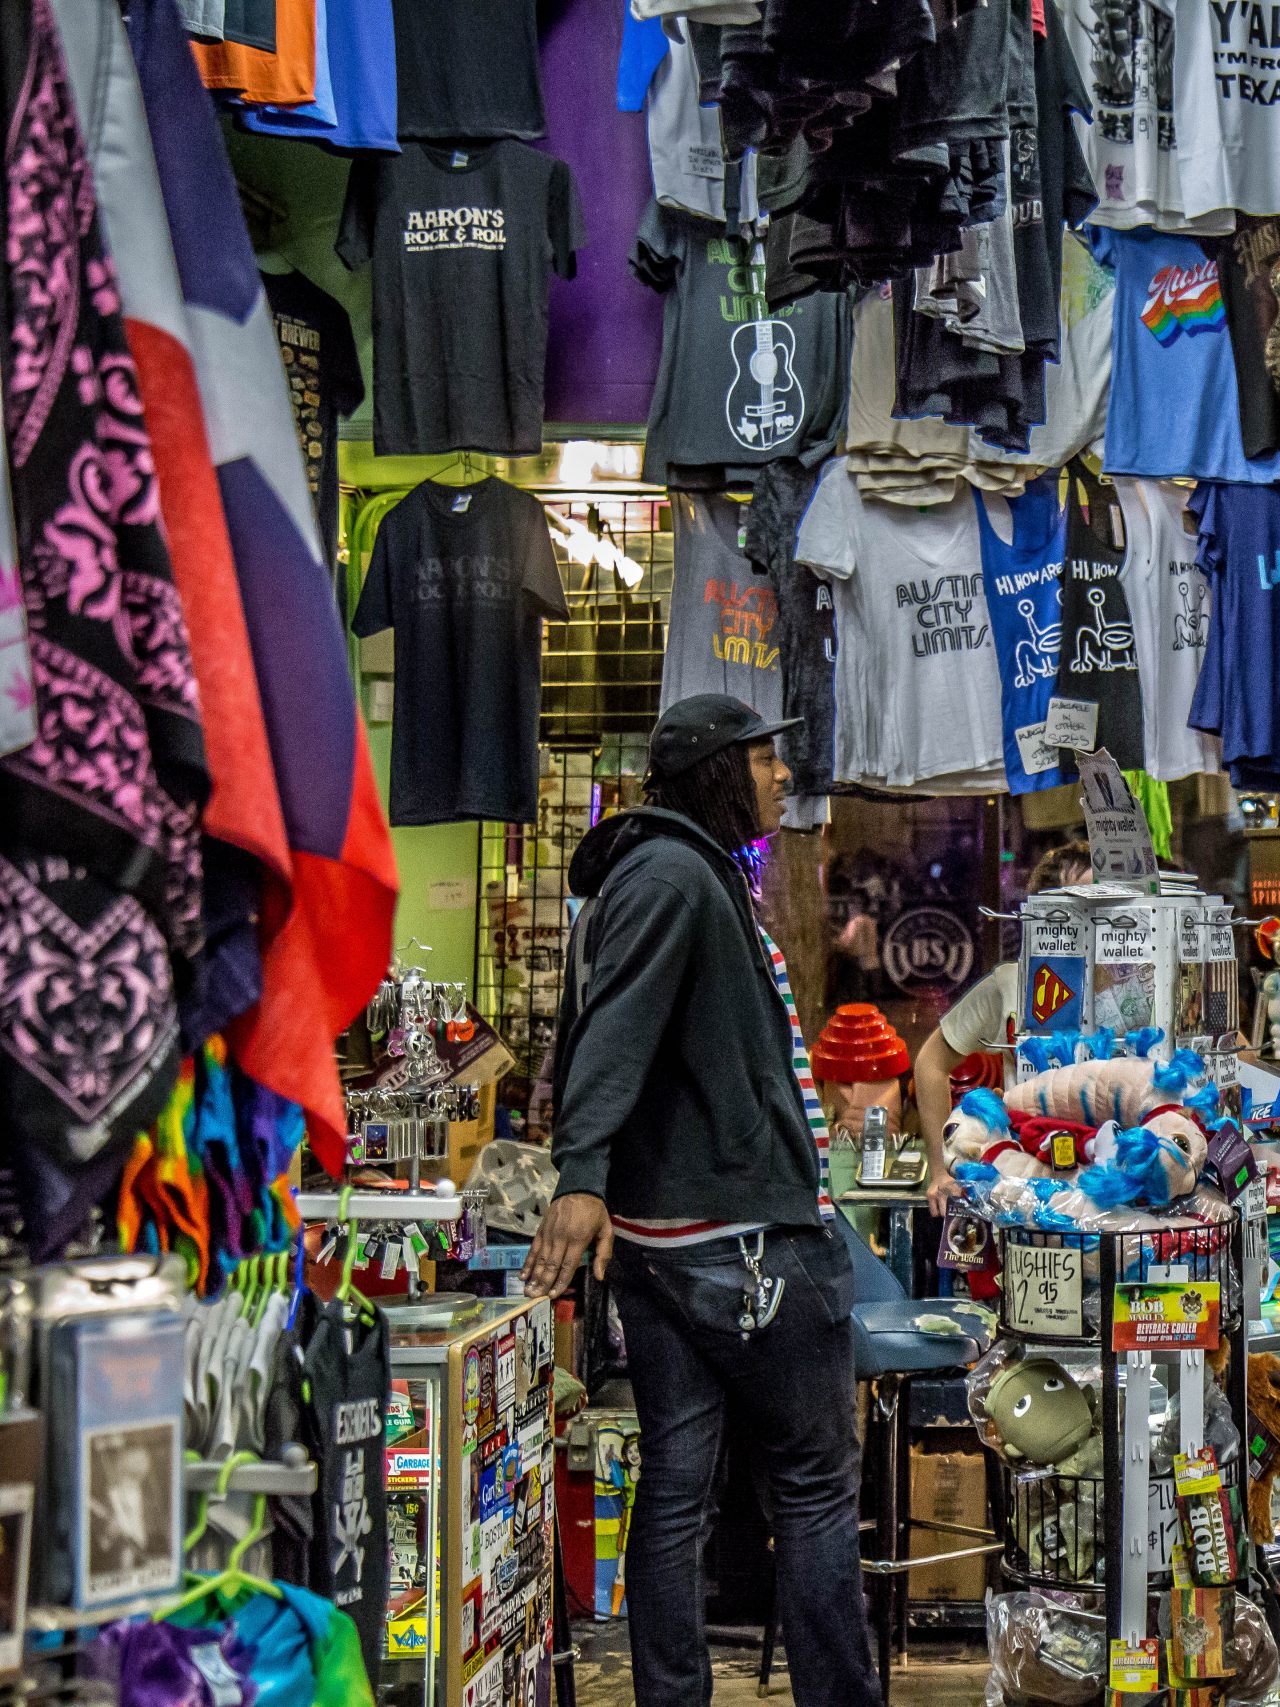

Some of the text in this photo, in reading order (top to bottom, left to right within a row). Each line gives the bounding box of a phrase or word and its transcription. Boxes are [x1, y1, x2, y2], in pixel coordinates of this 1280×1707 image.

[1213, 52, 1248, 64] I'M
[407, 206, 504, 230] AARON'S
[404, 228, 449, 245] ROCK
[472, 226, 507, 243] ROLL
[1040, 562, 1064, 585] ARE
[1093, 562, 1119, 581] HOW
[917, 599, 973, 629] CITY
[720, 608, 774, 641] CITY
[911, 624, 989, 659] LIMITS
[1036, 923, 1079, 938] mighty
[1101, 929, 1147, 944] mighty
[1210, 929, 1232, 944] mighty
[1038, 938, 1077, 952] wallet
[1103, 945, 1144, 958] wallet
[1211, 945, 1232, 958] wallet
[1219, 1056, 1236, 1072] mighty
[1220, 1072, 1236, 1085] wallet
[1251, 1104, 1273, 1121] ICE
[1249, 1201, 1265, 1213] wallet
[1038, 1280, 1058, 1302] 95
[1129, 1300, 1164, 1314] BOB
[1128, 1313, 1165, 1321] MARLEY
[1136, 1322, 1198, 1335] BEVERAGE COOLER
[393, 1418, 411, 1426] GUM
[1189, 1505, 1217, 1575] BOB
[1210, 1497, 1232, 1574] MARLEY
